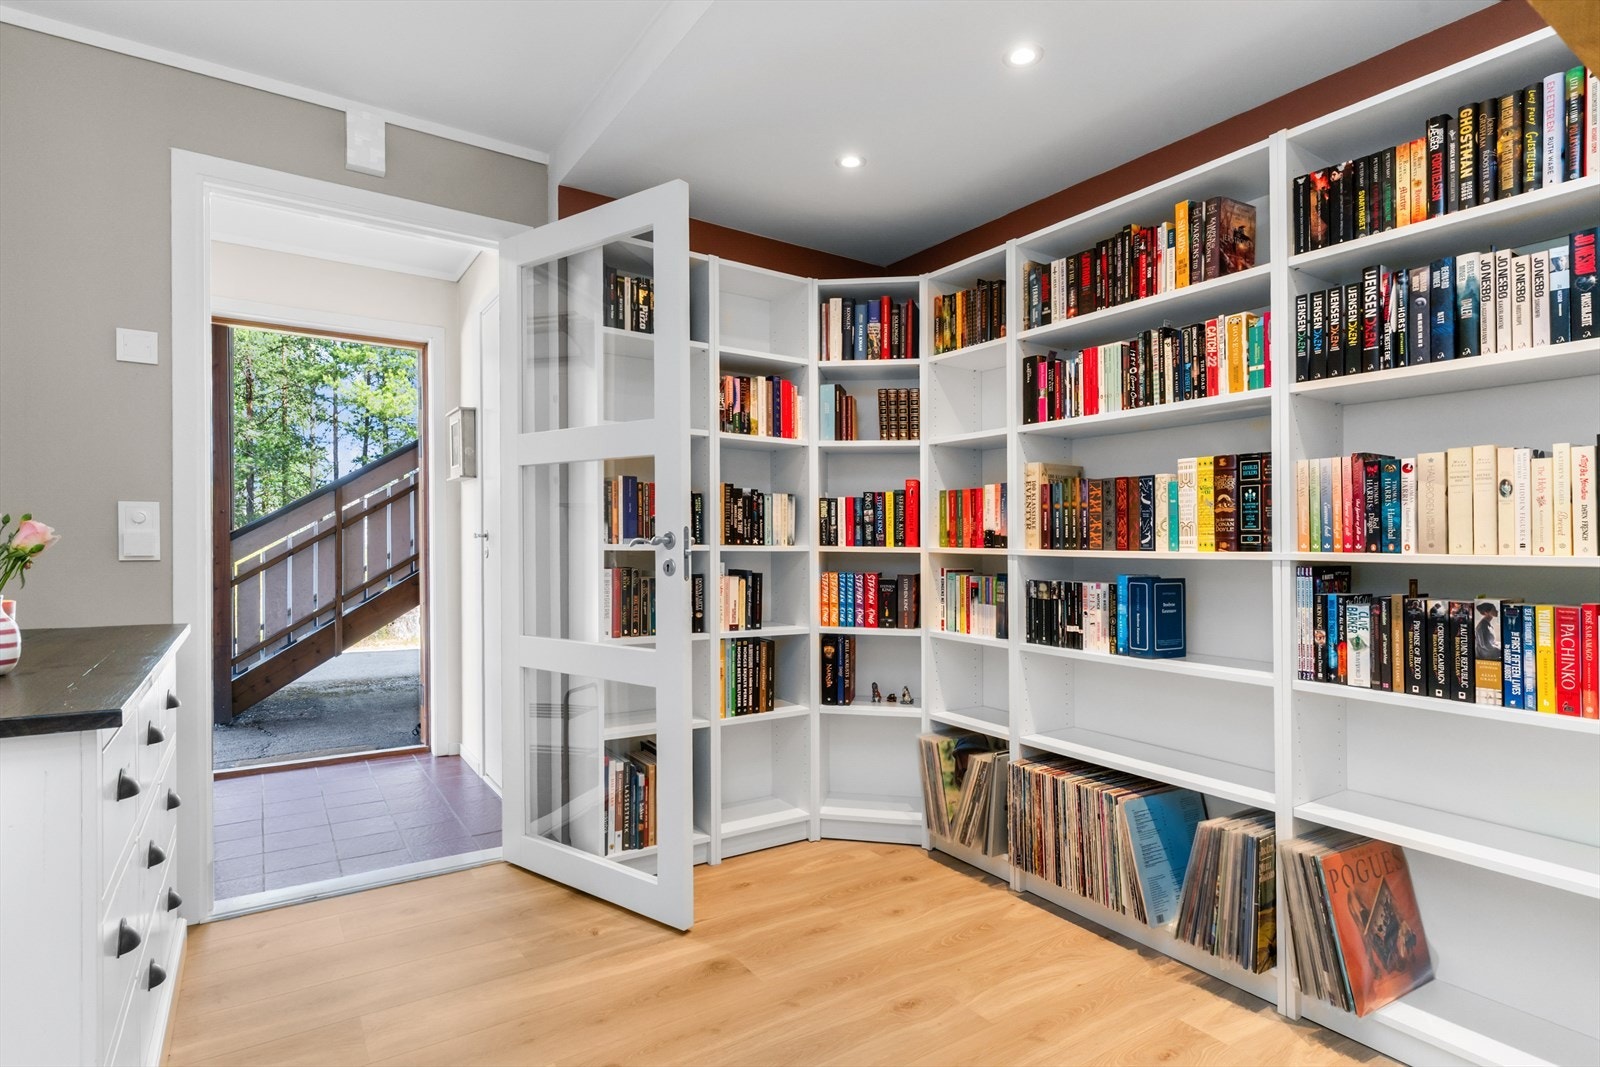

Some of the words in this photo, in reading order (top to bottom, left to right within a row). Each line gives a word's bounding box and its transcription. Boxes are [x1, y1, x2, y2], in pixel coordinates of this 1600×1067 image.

[1546, 95, 1556, 119] ETTER
[1479, 113, 1488, 149] GRISHAM
[1486, 117, 1496, 136] JOHN
[1460, 108, 1473, 179] GHOSTMAN
[1431, 152, 1443, 202] FORTIELSEN
[1482, 149, 1490, 179] ROOSTER
[1358, 190, 1366, 231] SVARTHUSET
[1177, 220, 1186, 256] SHARDS
[1192, 223, 1200, 259] VARGENS
[1481, 259, 1492, 272] JO
[1498, 256, 1509, 268] JO
[1515, 261, 1526, 273] JO
[1534, 257, 1545, 269] JO
[1481, 272, 1492, 303] NESBØ
[1498, 268, 1509, 300] NESBØ
[1515, 273, 1526, 303] NESBØ
[1534, 269, 1545, 298] NESBØ
[1398, 306, 1406, 333] HORST
[1206, 326, 1217, 367] CATCH-22
[740, 382, 748, 405] RILEY
[1384, 478, 1392, 507] HARRIS
[1519, 482, 1527, 510] HIDDEN
[1537, 477, 1546, 494] Help
[876, 495, 884, 519] STEPHEN
[876, 519, 884, 534] KING
[1387, 508, 1396, 540] Hannibal
[839, 573, 847, 603] STEPHEN
[854, 574, 864, 605] STEPHEN
[865, 574, 876, 605] STEPHEN
[1347, 607, 1359, 634] BARKER
[1358, 610, 1370, 632] CLIVE
[1460, 627, 1468, 656] AUTUMN
[1511, 636, 1521, 654] FIRST
[1584, 625, 1594, 661] SARAMAGO
[1413, 656, 1422, 680] BLOOD
[1511, 654, 1521, 678] FIFTEEN
[1560, 623, 1576, 691] PACHINKO
[1460, 656, 1468, 689] REPUBLIC
[1511, 678, 1521, 696] LIVES
[1328, 847, 1404, 893] POGUES
